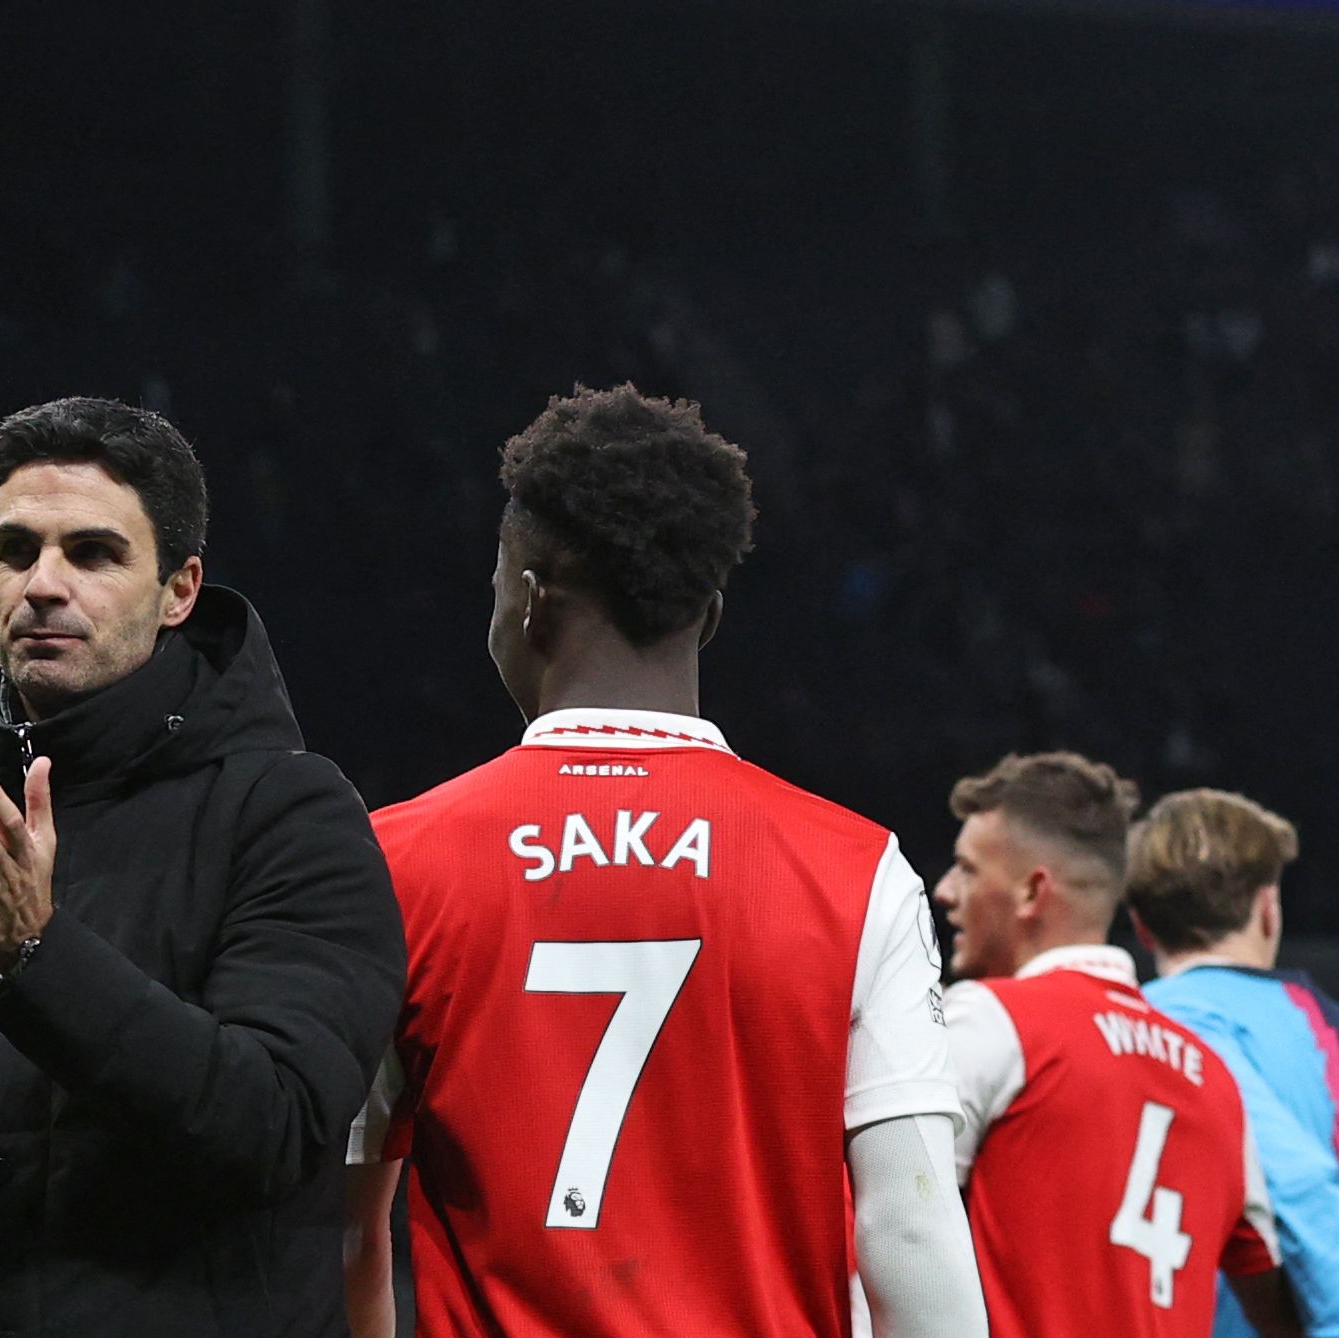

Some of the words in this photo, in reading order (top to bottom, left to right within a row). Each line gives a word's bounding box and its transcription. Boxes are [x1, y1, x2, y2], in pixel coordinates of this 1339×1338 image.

[557, 763, 650, 777] ARSENAL
[508, 809, 712, 881] SAKA
[523, 938, 702, 1230] 7
[1093, 1010, 1205, 1087] WHITE
[1109, 1101, 1193, 1309] 4
